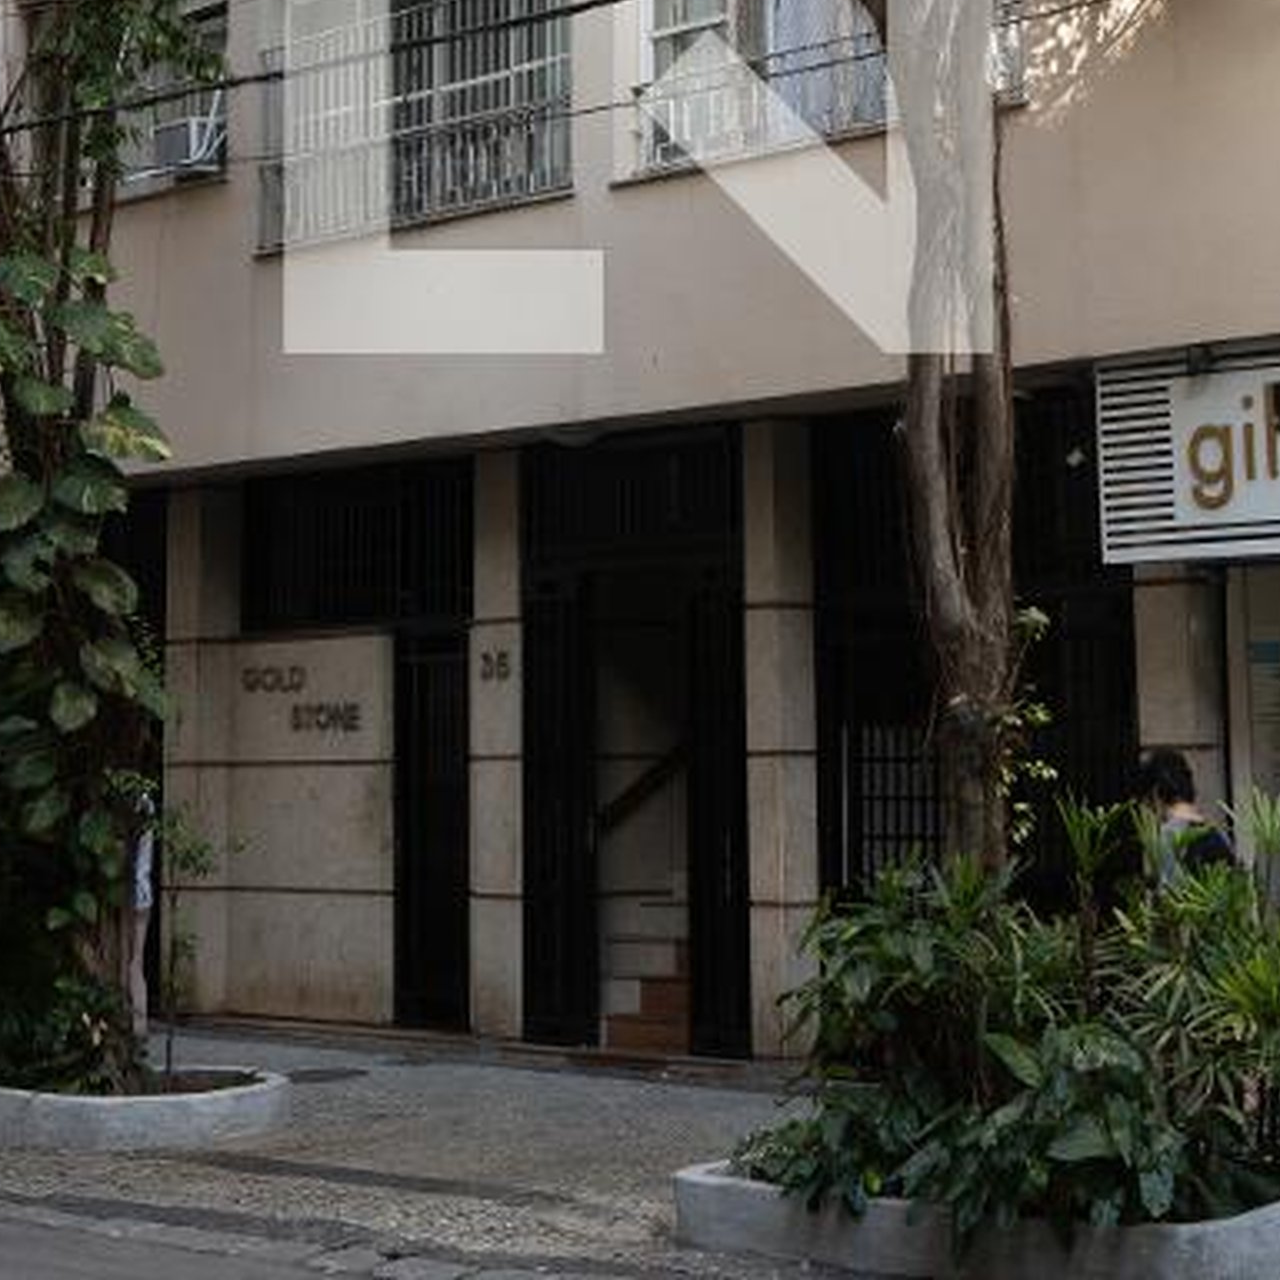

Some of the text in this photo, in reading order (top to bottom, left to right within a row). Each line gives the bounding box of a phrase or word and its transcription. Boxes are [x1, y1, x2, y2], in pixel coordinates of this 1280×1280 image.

[1186, 382, 1280, 510] gil
[241, 665, 307, 694] GOLD
[291, 701, 362, 733] STONE
